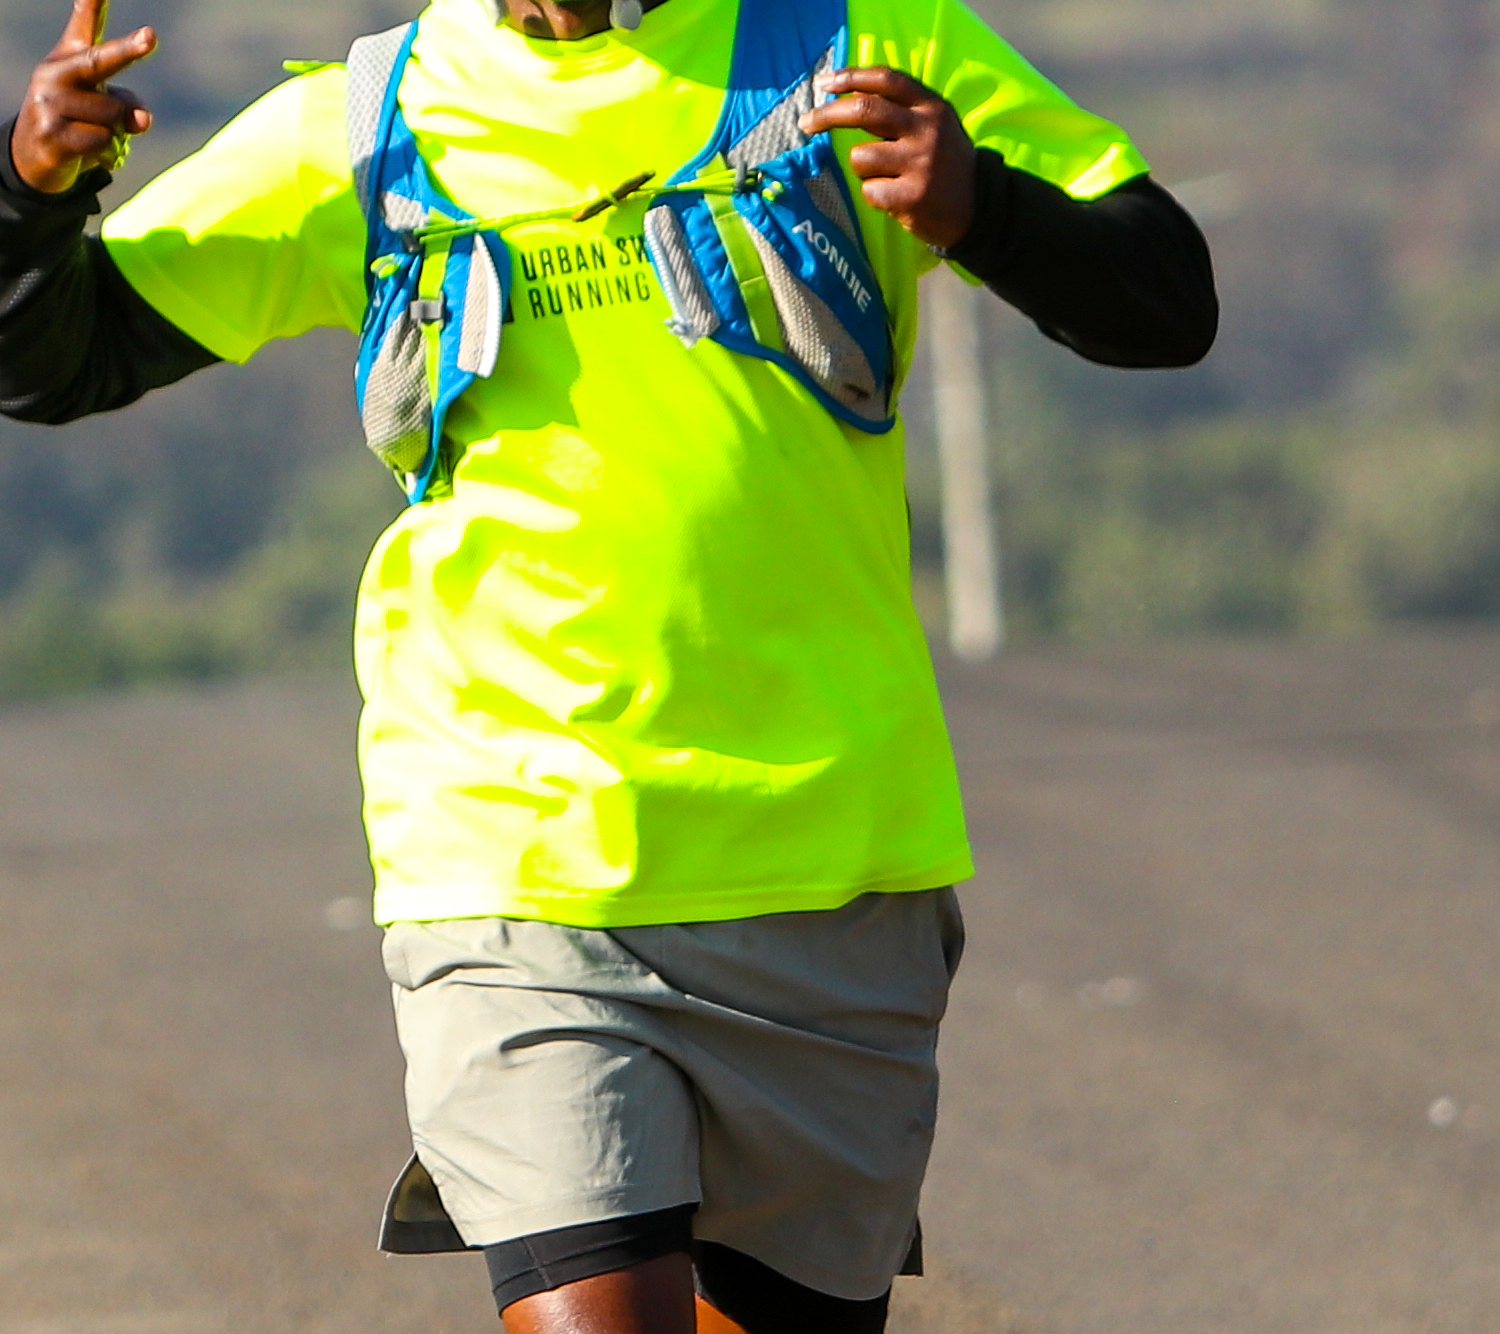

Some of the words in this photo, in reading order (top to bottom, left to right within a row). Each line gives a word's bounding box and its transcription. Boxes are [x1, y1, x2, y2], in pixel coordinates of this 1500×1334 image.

[520, 242, 606, 281] URBAN
[792, 219, 871, 313] AONIJIE
[527, 271, 651, 319] RUNNING
